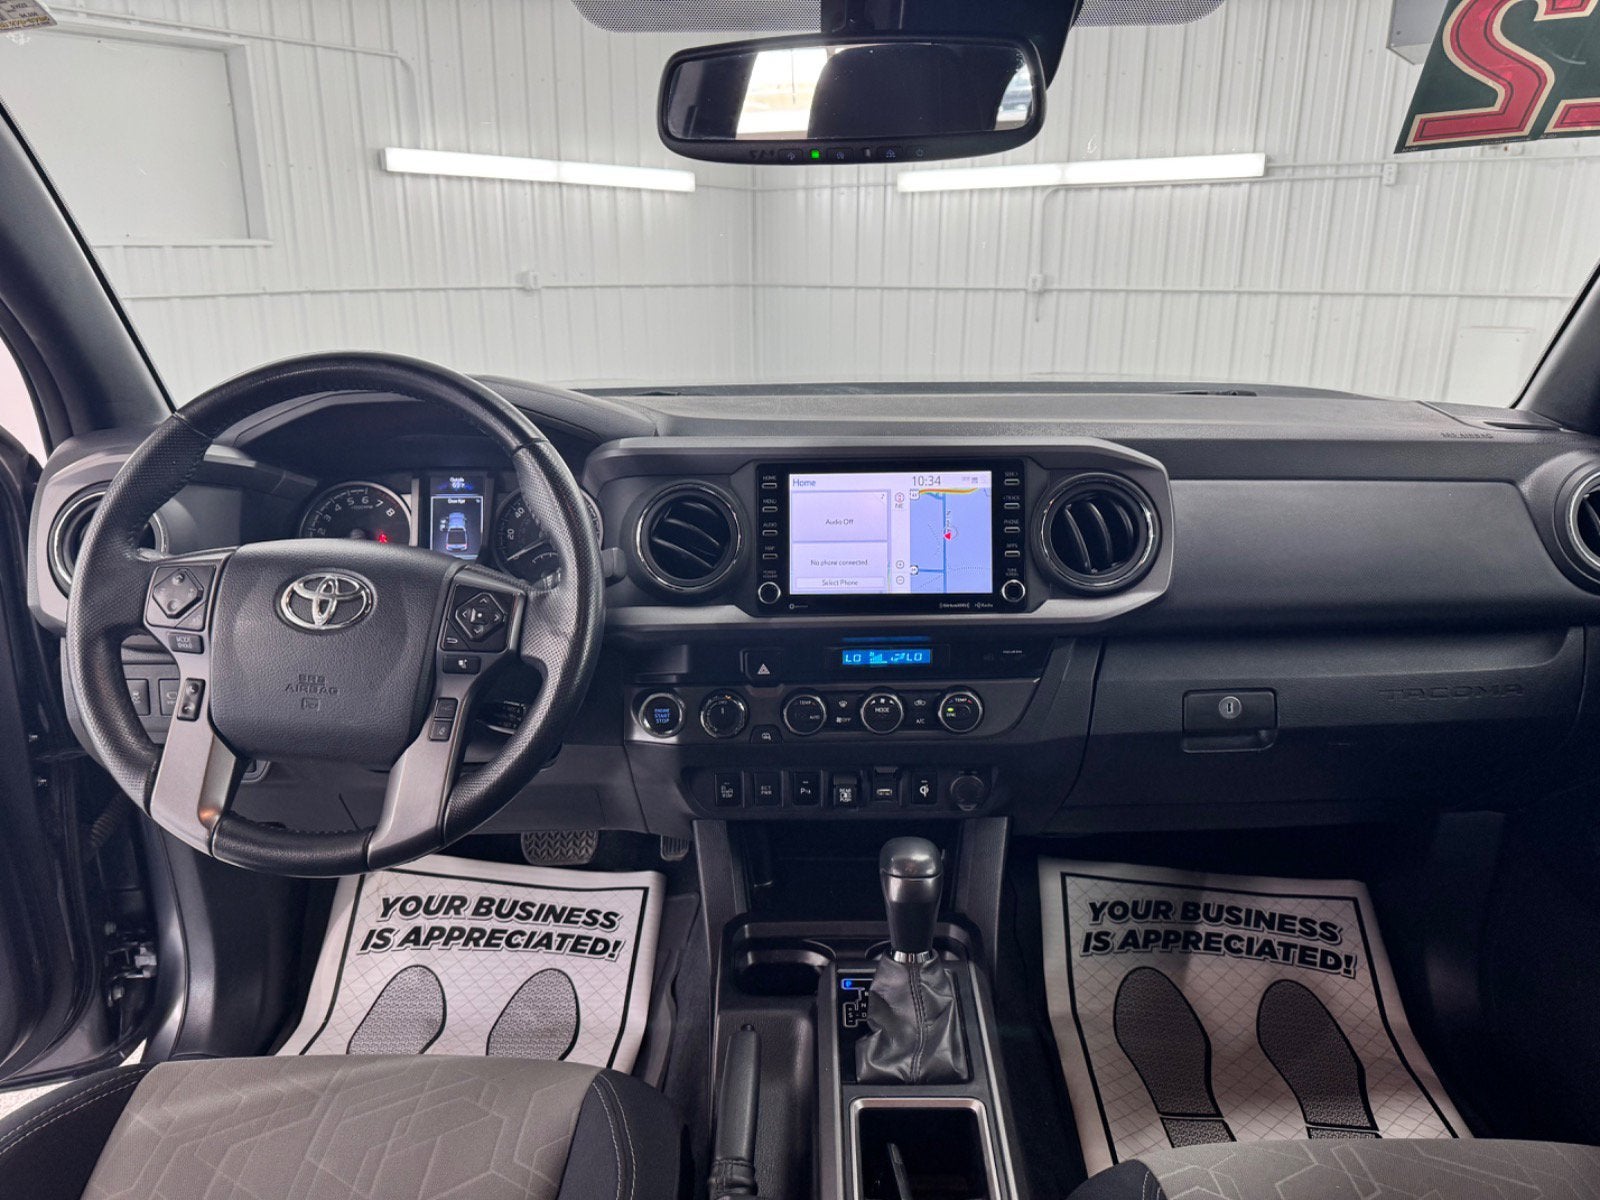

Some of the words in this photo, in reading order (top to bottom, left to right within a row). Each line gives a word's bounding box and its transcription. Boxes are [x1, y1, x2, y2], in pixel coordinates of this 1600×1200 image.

[792, 479, 816, 487] Home
[912, 475, 941, 486] 10:34
[347, 497, 355, 505] 5
[361, 496, 369, 504] 6
[375, 500, 384, 508] 7
[334, 503, 342, 511] 4
[385, 507, 395, 517] 8
[514, 507, 525, 518] 40
[845, 653, 862, 662] LO
[906, 652, 923, 662] LO
[285, 683, 339, 695] AIRBAG
[1379, 684, 1523, 702] TACOMA
[378, 894, 467, 922] YOUR
[471, 896, 621, 930] BUSINESS
[1088, 899, 1176, 923] YOUR
[1179, 901, 1343, 942] BUSINESS
[360, 927, 394, 952] IS
[399, 926, 623, 958] APPRECIATED!
[1081, 930, 1115, 956] IS
[1116, 929, 1357, 976] APPRECIATED!
